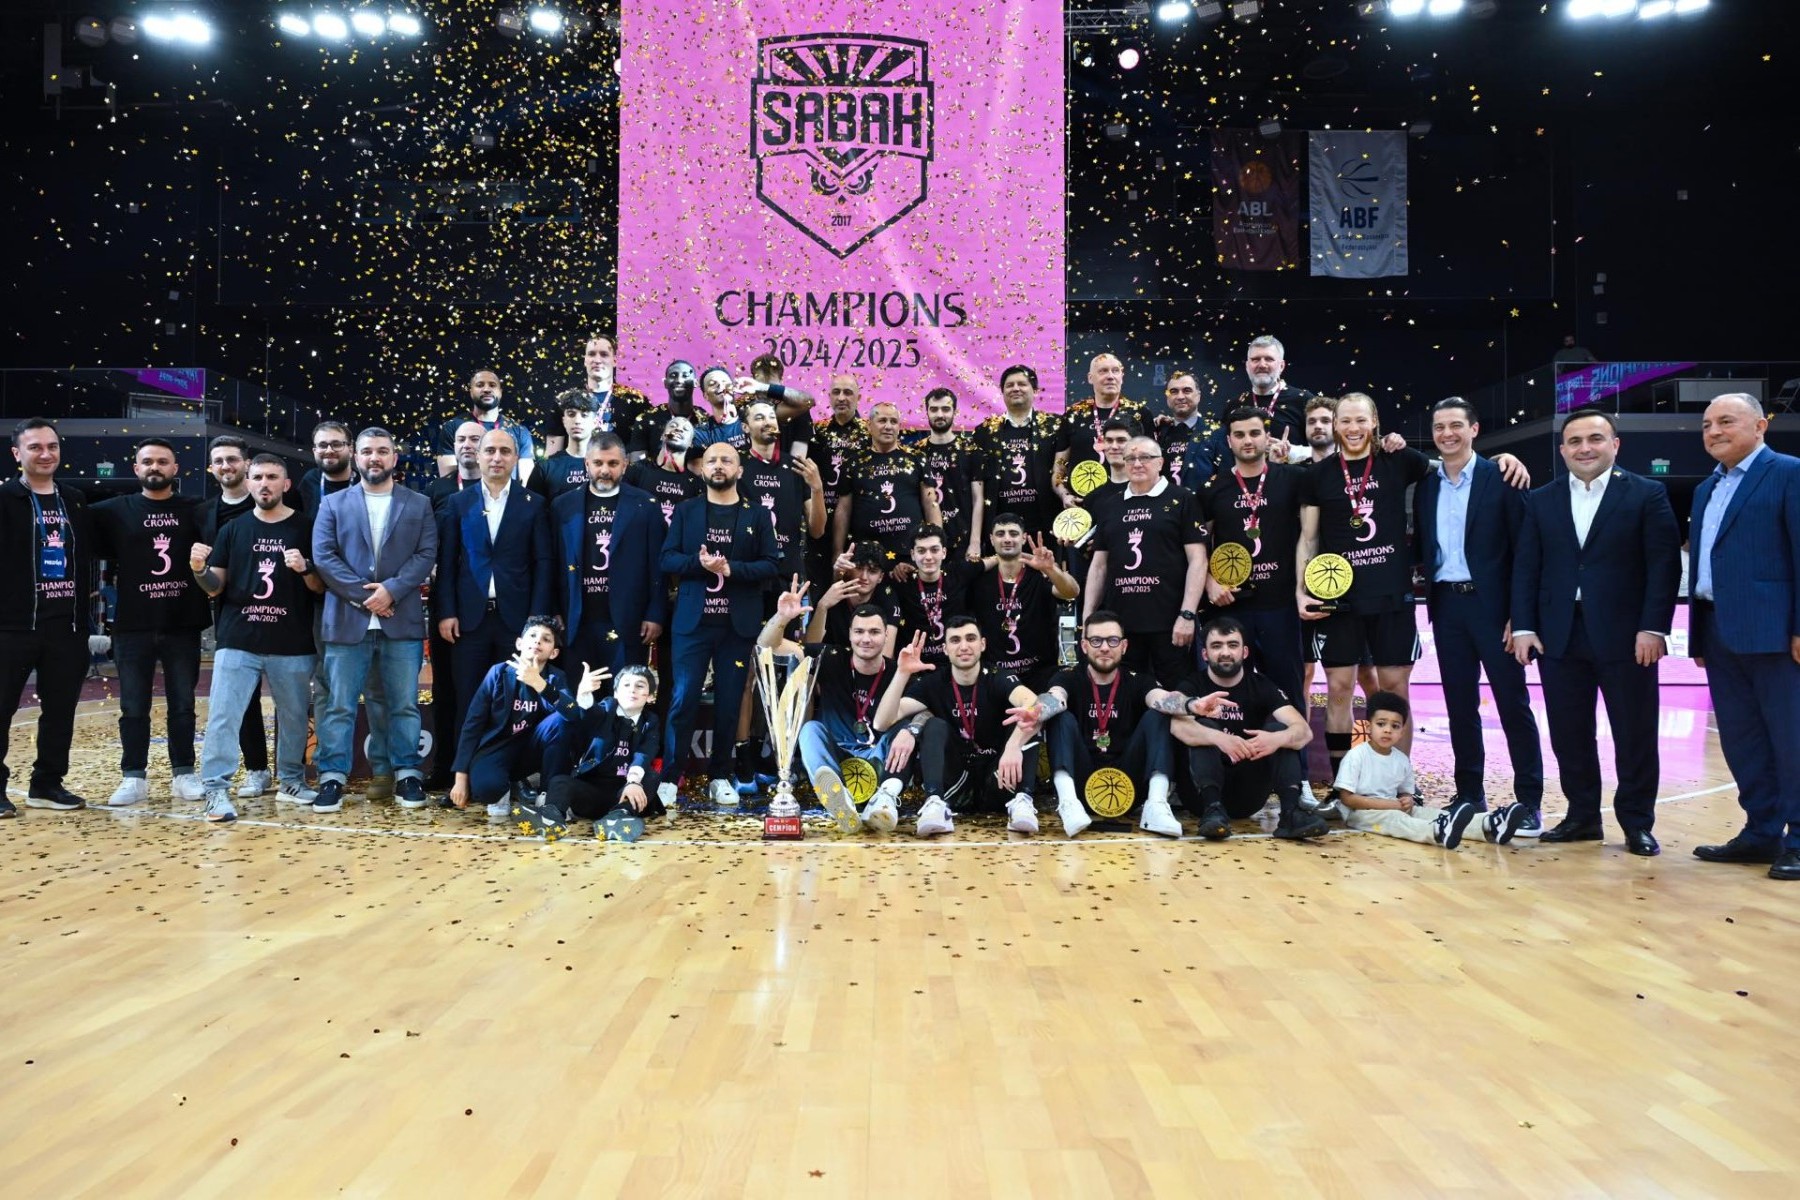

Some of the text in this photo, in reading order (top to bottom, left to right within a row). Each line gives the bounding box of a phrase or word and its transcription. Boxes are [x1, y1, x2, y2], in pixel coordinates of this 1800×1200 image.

[763, 90, 922, 148] SABAH
[1237, 201, 1273, 217] ABL
[831, 215, 852, 227] 2017
[1340, 207, 1379, 229] ABF
[715, 290, 968, 328] CHAMPIONS
[763, 336, 921, 369] 2024/2025
[1011, 463, 1027, 485] 3
[754, 480, 781, 488] CROWN
[656, 485, 684, 496] CROWN
[999, 488, 1038, 498] CHAMPION
[143, 518, 179, 528] CROWN
[588, 515, 615, 524] CROW
[1122, 513, 1152, 523] CROWN
[1355, 508, 1377, 542] 3
[706, 534, 732, 543] CROWN
[252, 543, 287, 553] CROWN
[1341, 544, 1395, 560] CHAMPIONS
[151, 545, 172, 576] 3
[591, 539, 610, 571] 3
[1124, 538, 1143, 571] 3
[1253, 561, 1279, 572] PIONS
[1115, 576, 1160, 587] CHAMPIONS
[1249, 572, 1271, 581] /2025
[36, 581, 75, 592] CHAMPIO
[139, 580, 188, 592] CHAMPIONS
[252, 567, 275, 600] 3
[587, 585, 609, 593] 2024/2
[150, 590, 181, 599] 2024/2025
[241, 605, 288, 616] CHAMPIONS
[1006, 626, 1021, 655] 3
[513, 699, 538, 713] BAH
